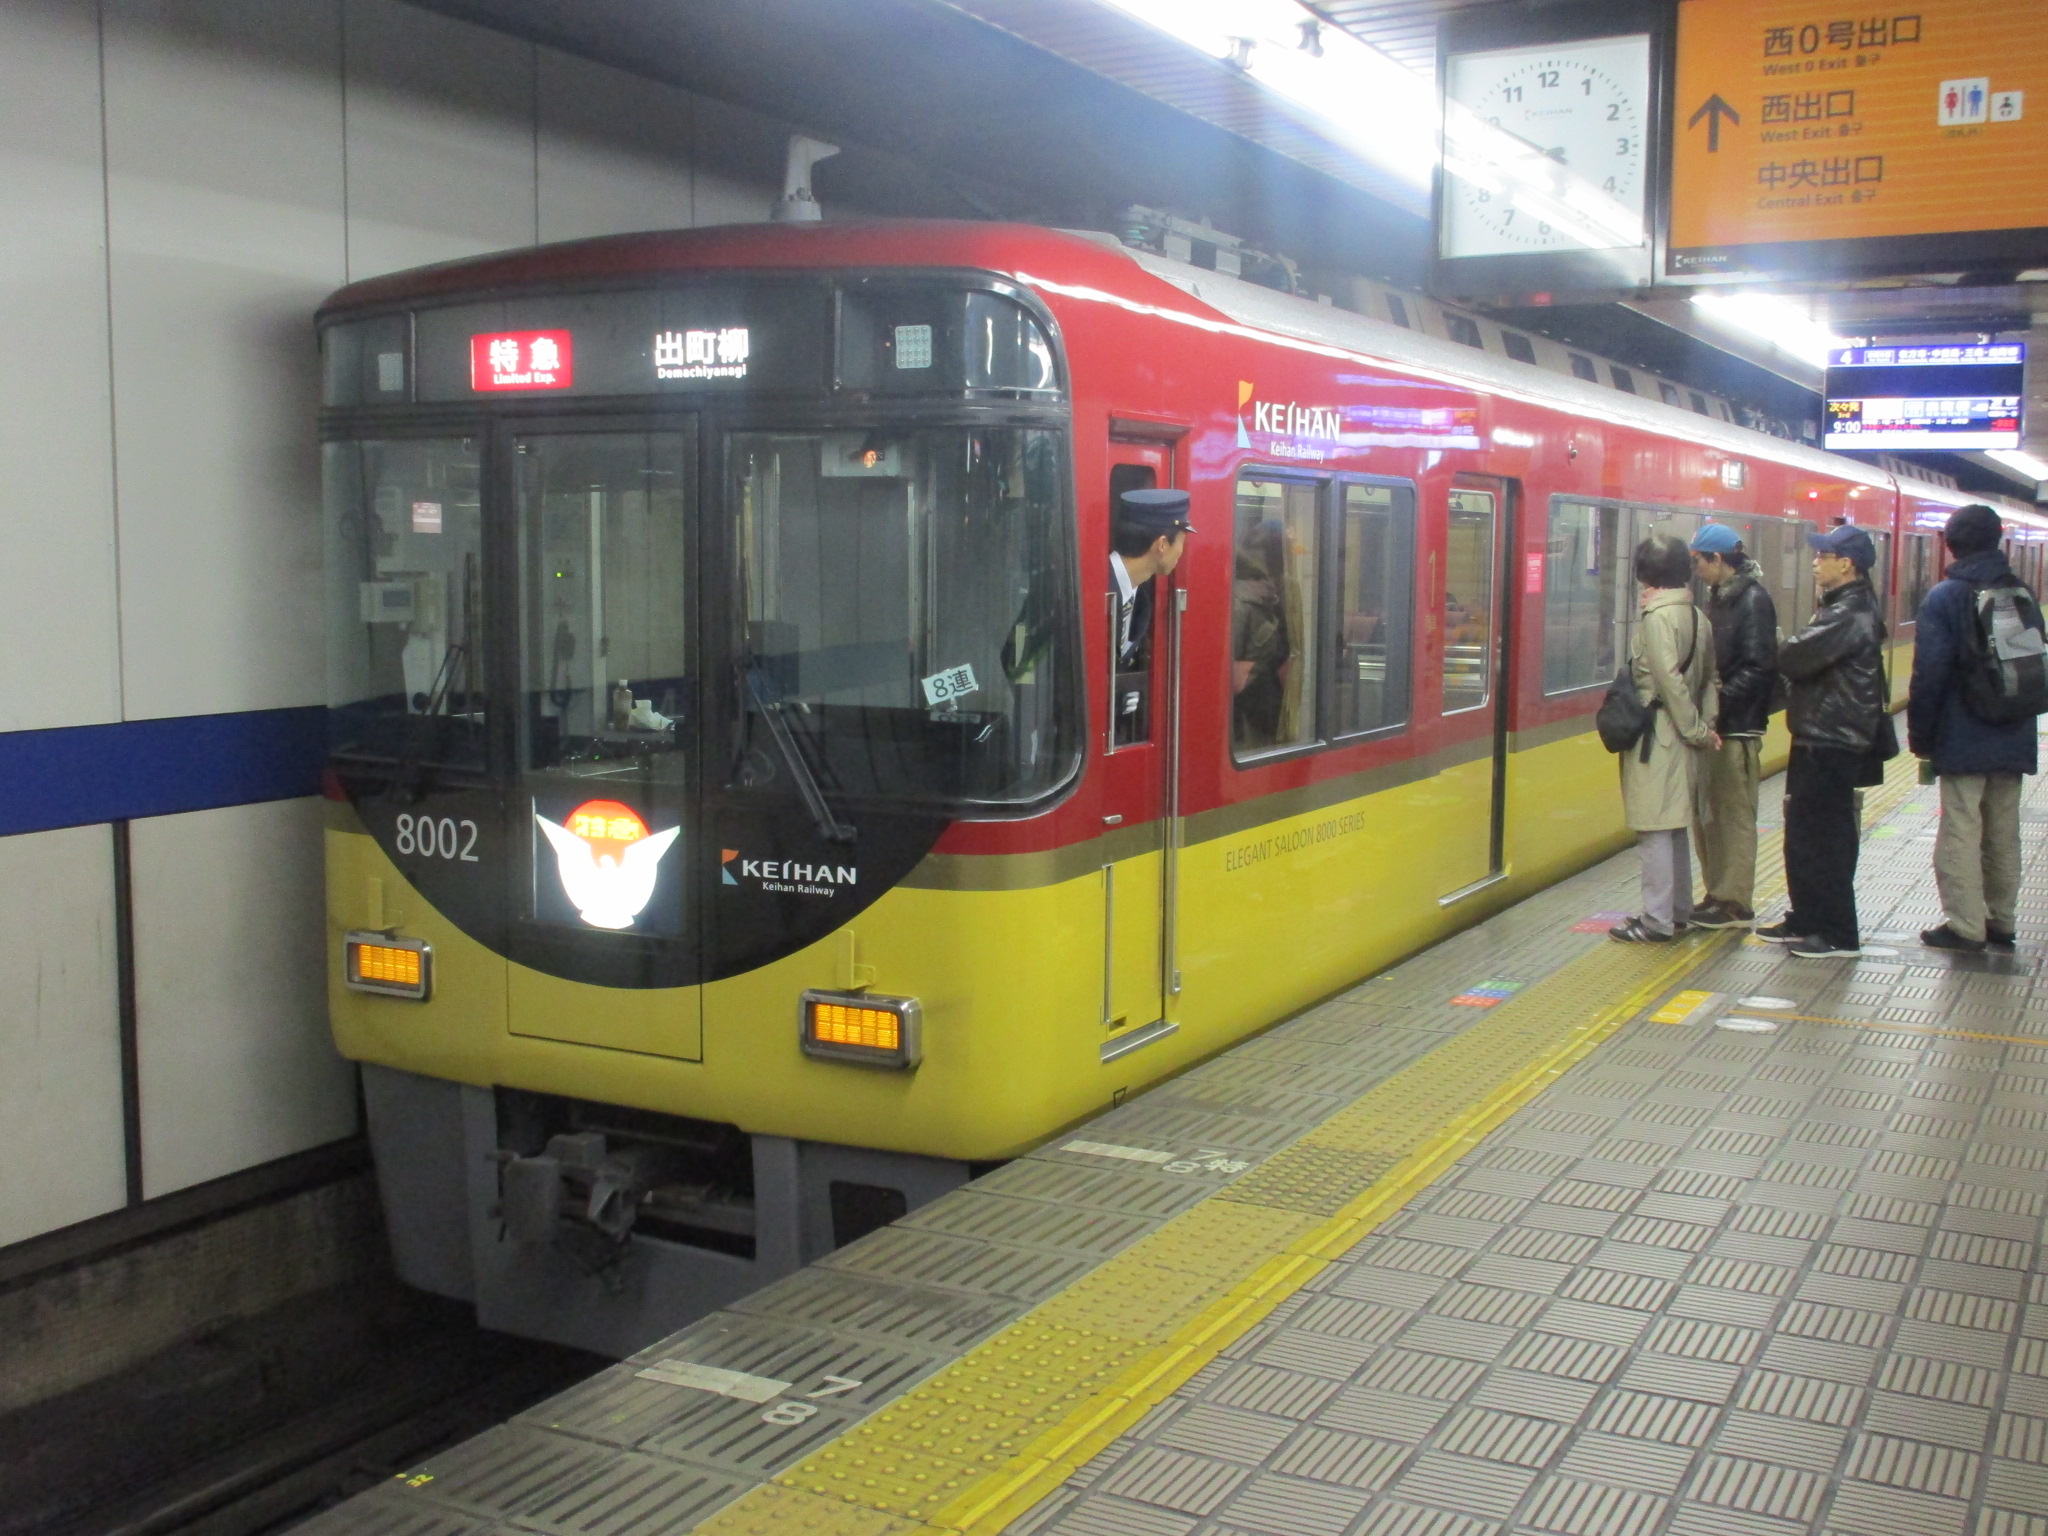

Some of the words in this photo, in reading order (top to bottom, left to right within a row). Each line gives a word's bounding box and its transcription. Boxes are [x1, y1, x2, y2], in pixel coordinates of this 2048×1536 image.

[1764, 15, 1921, 57] 西0号出口
[1763, 62, 1800, 76] West
[1804, 60, 1814, 72] 0
[1819, 58, 1846, 71] Exit
[1537, 70, 1560, 88] 12
[1581, 78, 1591, 96] 1
[1502, 86, 1523, 103] 11
[1606, 103, 1620, 121] 2
[1762, 89, 1854, 125] 西出口
[1760, 129, 1798, 143] West
[1803, 127, 1830, 140] Exit
[1615, 138, 1629, 156] 3
[1758, 155, 1884, 190] 中央出口
[1602, 176, 1616, 193] 4
[1757, 194, 1810, 209] Central
[1816, 193, 1844, 206] Exit
[1503, 209, 1516, 226] 7
[1538, 220, 1551, 235] 6
[1683, 255, 1727, 265] KEIHAN
[490, 337, 560, 372] 特急
[655, 328, 749, 367] 出町柳
[1840, 352, 1853, 365] 4
[657, 363, 747, 380] Demachiyanagi
[1255, 400, 1341, 442] KEIHAN
[1833, 420, 1861, 434] 9:00
[1270, 441, 1296, 458] Keihan
[1297, 443, 1325, 464] Railway
[933, 669, 974, 698] 8連
[575, 814, 640, 841] 特急
[396, 812, 480, 863] 8002
[1226, 838, 1273, 873] ELEGANT
[1275, 827, 1314, 857] SALOON
[1316, 819, 1337, 844] 8000
[1338, 811, 1366, 837] SERIES
[742, 859, 857, 885] KEIHAN
[762, 881, 795, 893] Keihan
[797, 884, 835, 898] Railway
